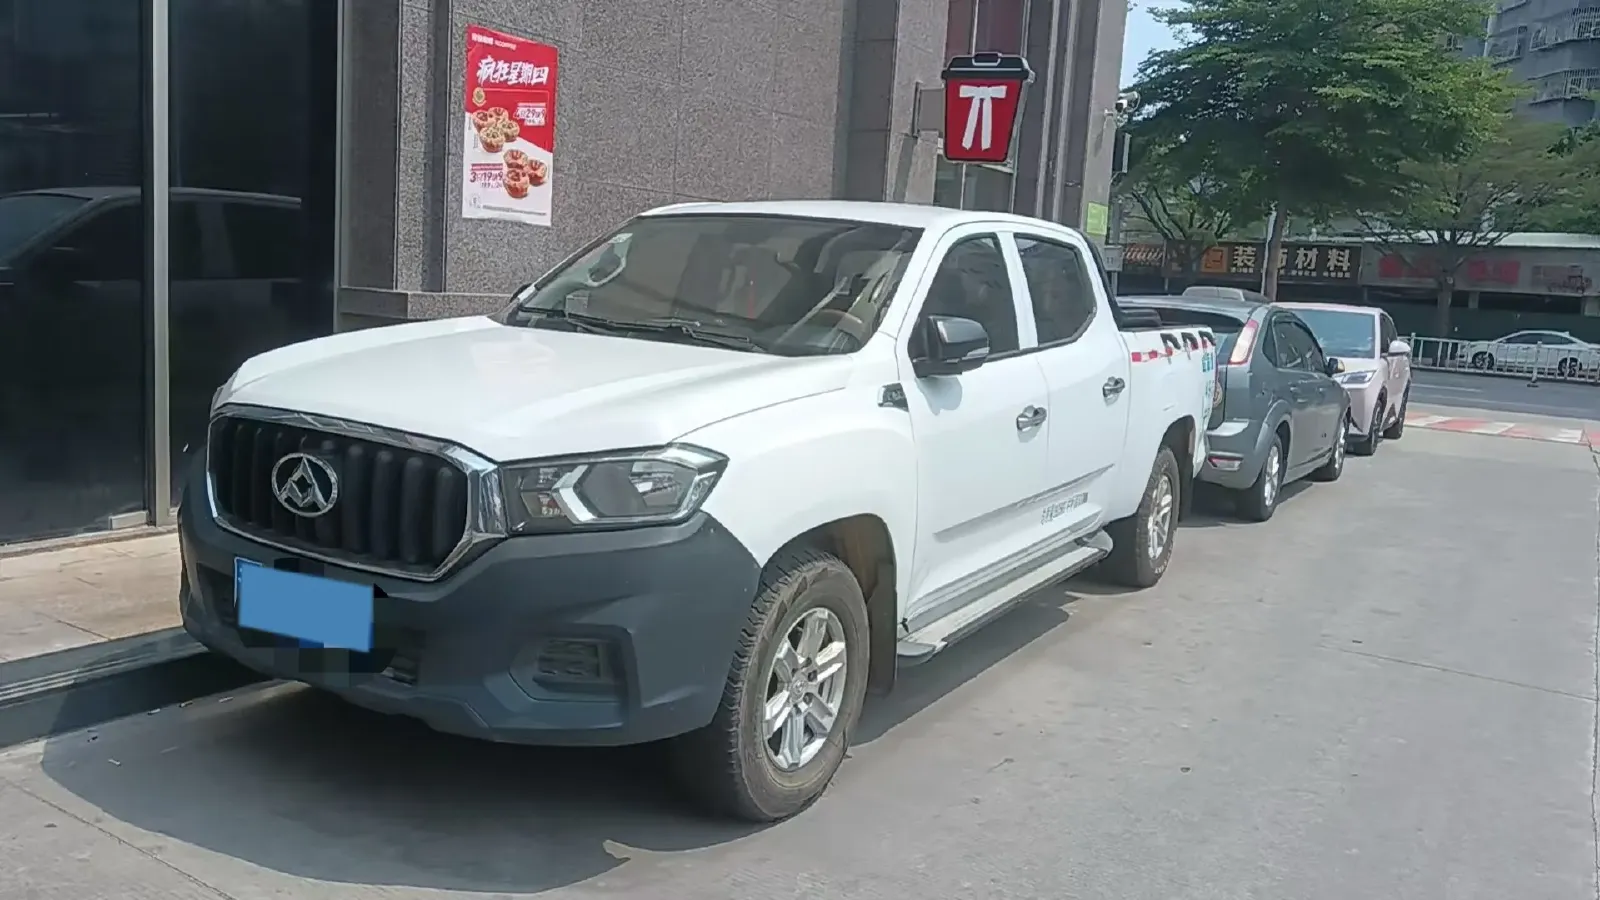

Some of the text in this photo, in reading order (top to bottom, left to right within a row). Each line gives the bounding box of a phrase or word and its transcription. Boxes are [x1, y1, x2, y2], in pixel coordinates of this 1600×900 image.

[477, 55, 549, 86] 疯狂星期四
